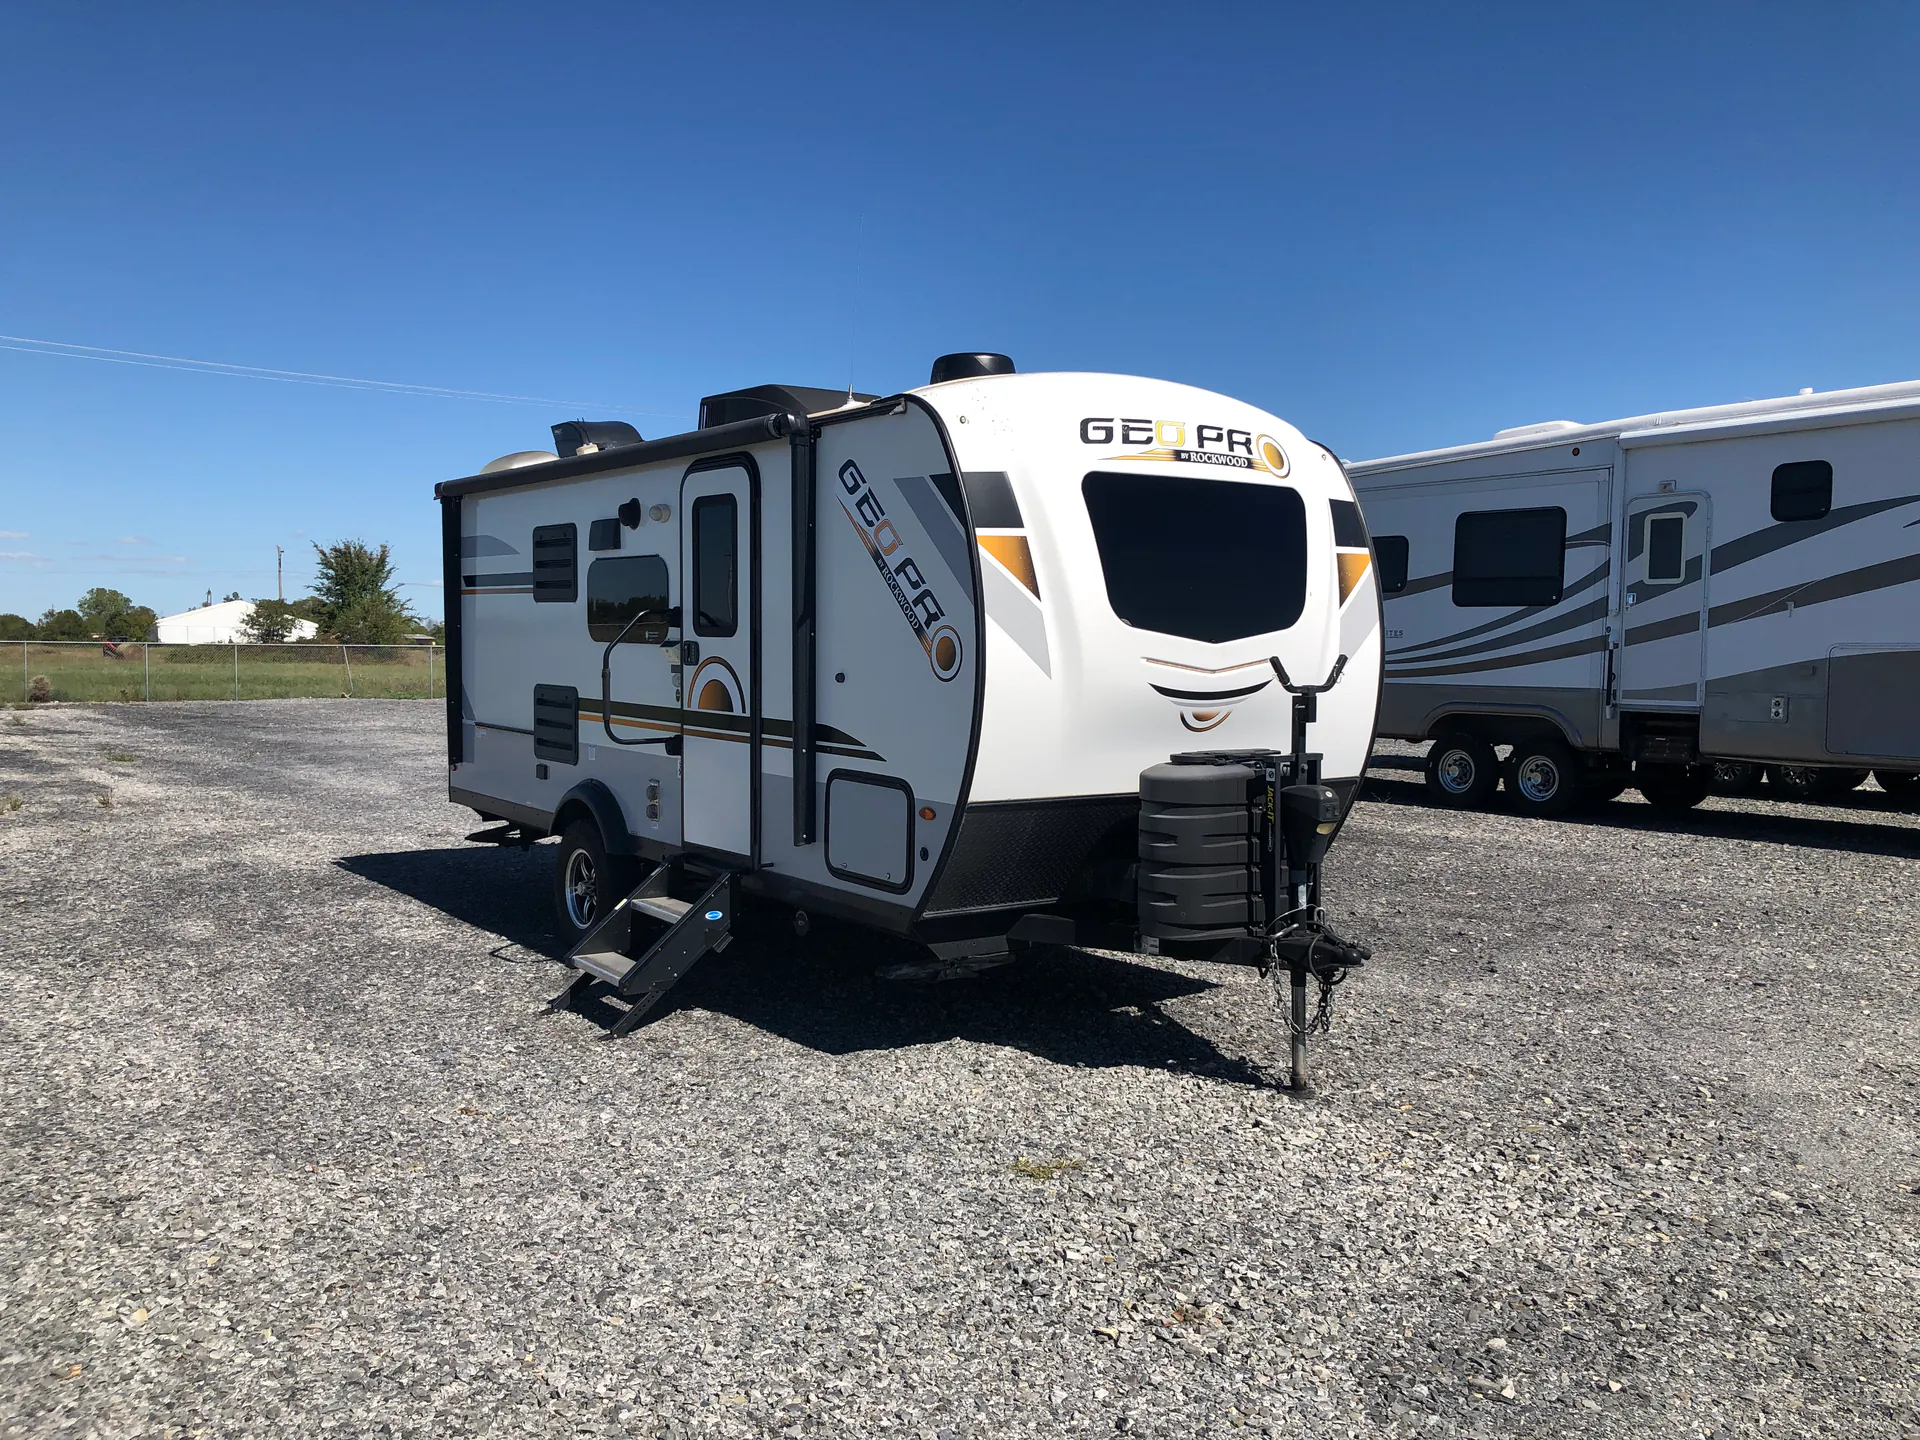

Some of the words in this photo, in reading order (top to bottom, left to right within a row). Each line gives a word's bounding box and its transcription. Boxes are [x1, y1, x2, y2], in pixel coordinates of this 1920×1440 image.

[1080, 418, 1186, 447] GEO
[1190, 453, 1248, 468] ROCKWOOD
[838, 459, 903, 556] GEO
[877, 558, 885, 568] BY
[881, 566, 920, 629] ROCKWOOD
[1267, 784, 1275, 824] JACK-IT
